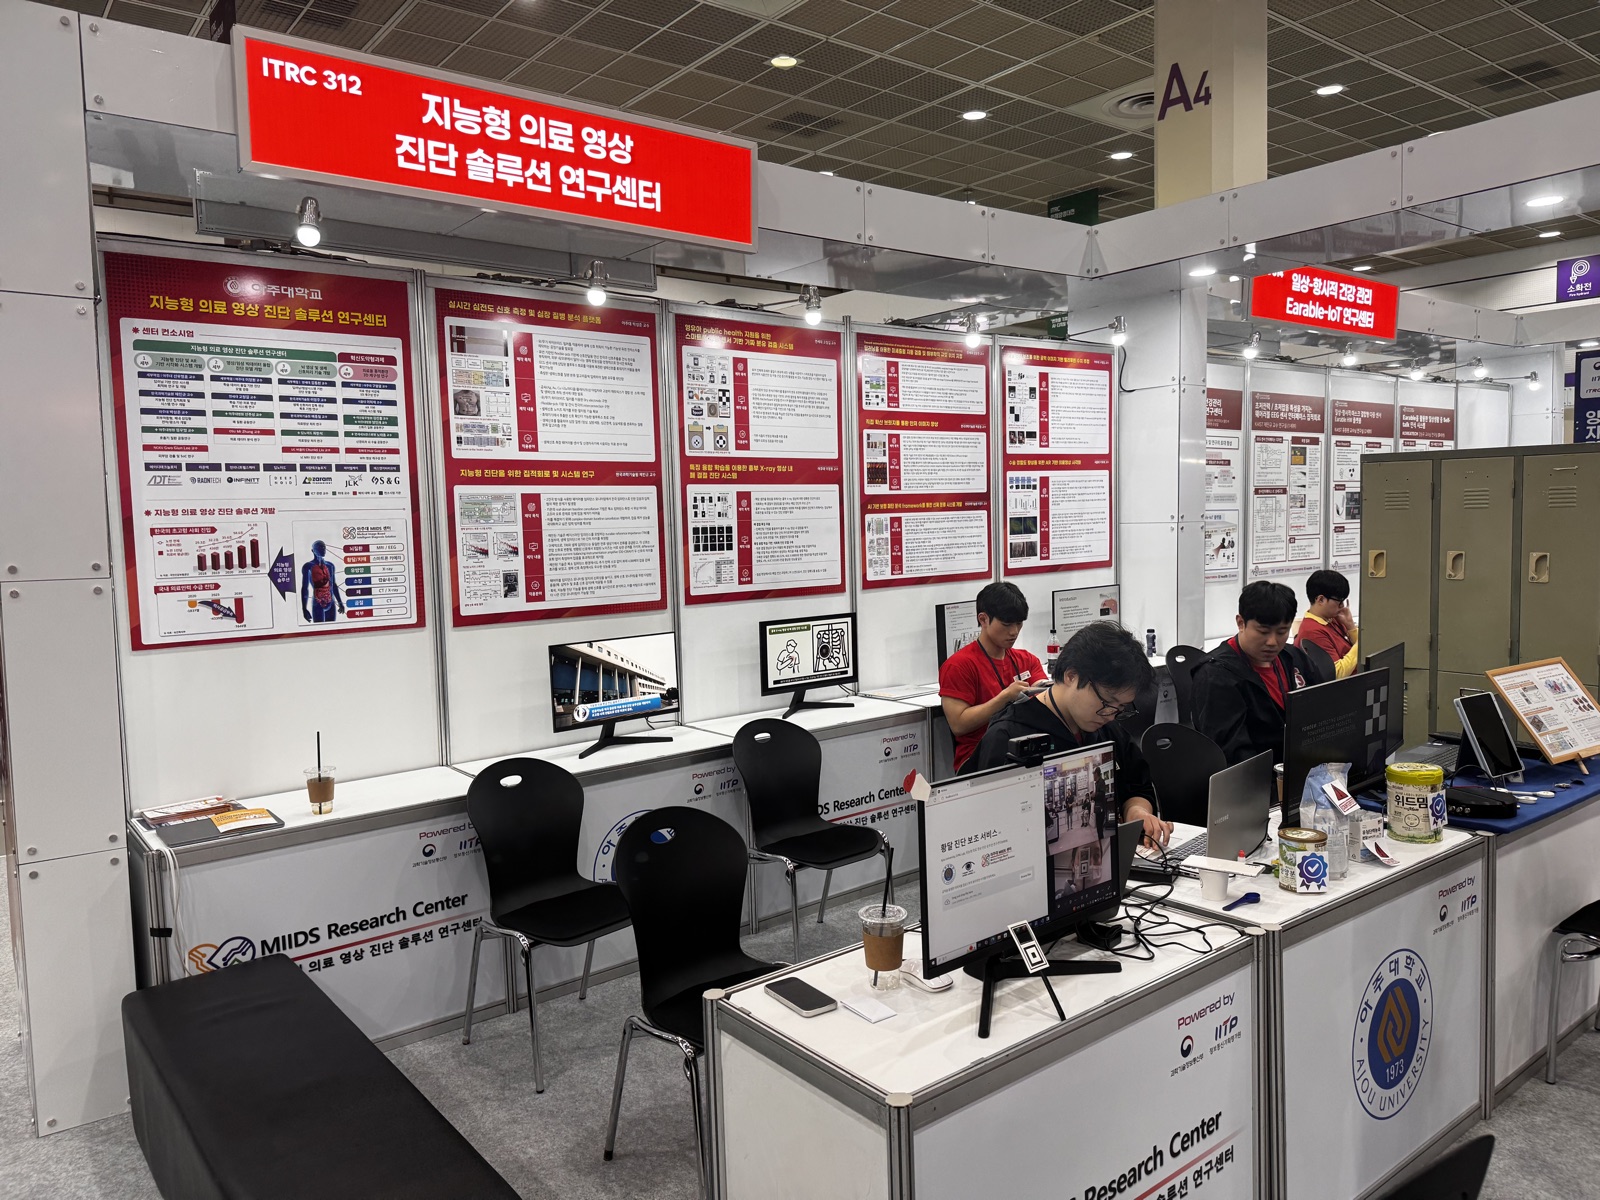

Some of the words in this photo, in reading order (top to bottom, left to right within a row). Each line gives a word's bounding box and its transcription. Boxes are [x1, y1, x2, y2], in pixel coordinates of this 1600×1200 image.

[262, 56, 317, 86] ITRC
[322, 69, 363, 96] 312
[1157, 62, 1212, 121] A4
[421, 93, 511, 141] 지능형
[519, 113, 575, 153] 의료
[581, 126, 634, 165] 영상
[395, 133, 459, 177] 진단
[465, 148, 552, 193] 솔루션
[559, 164, 662, 213] 연구센터
[1291, 272, 1339, 300] 일상-항시적
[1339, 283, 1356, 303] 건강
[1567, 282, 1592, 293] 소화전
[150, 295, 194, 312] 지능형
[199, 299, 228, 315] 의료
[231, 302, 260, 317] 영상
[264, 304, 291, 320] 진단
[295, 308, 334, 323] 솔루션
[337, 311, 387, 327] 연구센터
[448, 300, 471, 310] 실시간
[473, 303, 495, 313] 심전도
[496, 306, 511, 314] 신호
[513, 307, 526, 316] 측정
[528, 309, 535, 317] 및
[537, 310, 551, 318] 심장
[552, 312, 566, 320] 질병
[568, 314, 581, 322] 분석
[583, 315, 601, 324] 플랫폼
[1286, 297, 1343, 323] Earable-IoT
[1342, 307, 1374, 329] 연구센터
[142, 327, 159, 336] 센터
[161, 328, 195, 338] 컨소시엄
[685, 324, 702, 332] 영유아
[703, 327, 723, 335] public
[724, 329, 744, 337] health
[761, 332, 771, 340] 위한
[222, 346, 234, 354] 영상
[247, 348, 264, 356] 솔루션
[265, 350, 287, 358] 연구센터
[779, 342, 794, 350] 시스템
[460, 469, 482, 477] 지능형
[484, 469, 505, 478] 진단을
[507, 470, 522, 478] 위한
[523, 470, 550, 478] 집적회로
[552, 470, 559, 478] 및
[560, 470, 580, 478] 시스템
[582, 470, 595, 478] 연구
[760, 465, 776, 473] X-ray
[154, 509, 179, 517] 지능형
[181, 508, 197, 516] 의료
[260, 507, 275, 515] 개발
[882, 734, 908, 744] Powered
[908, 732, 916, 740] by
[903, 743, 918, 753] IITP
[692, 768, 725, 780] Powered
[726, 766, 736, 775] by
[720, 778, 739, 790] IITP
[833, 792, 875, 812] Research
[870, 810, 890, 823] 솔루션
[892, 804, 916, 817] 연구센터
[419, 823, 466, 840] Powered
[940, 842, 953, 853] 황달
[954, 838, 966, 849] 진단
[967, 834, 979, 844] 보조
[980, 829, 998, 841] 서비스
[1438, 877, 1467, 900] Powered
[1467, 875, 1476, 887] by
[1461, 894, 1477, 913] IITP
[260, 927, 321, 956] MIIDS
[327, 906, 407, 941] Research
[412, 893, 468, 918] Center
[308, 956, 335, 974] 의료
[339, 947, 365, 966] 영상
[369, 940, 395, 958] 진단
[398, 929, 435, 951] 솔루션
[438, 916, 484, 939] 연구센터
[1360, 954, 1427, 1023] 아주대학교
[1177, 996, 1222, 1031] Powered
[1223, 991, 1236, 1011] by
[1214, 1014, 1239, 1042] IITP
[1356, 1057, 1376, 1106] AJOU
[1379, 1019, 1430, 1112] UNIVERSITY
[1386, 1058, 1405, 1083] 1973
[1084, 1144, 1165, 1200] Research
[1169, 1111, 1222, 1159] Center
[1192, 1144, 1235, 1189] 연구센터
